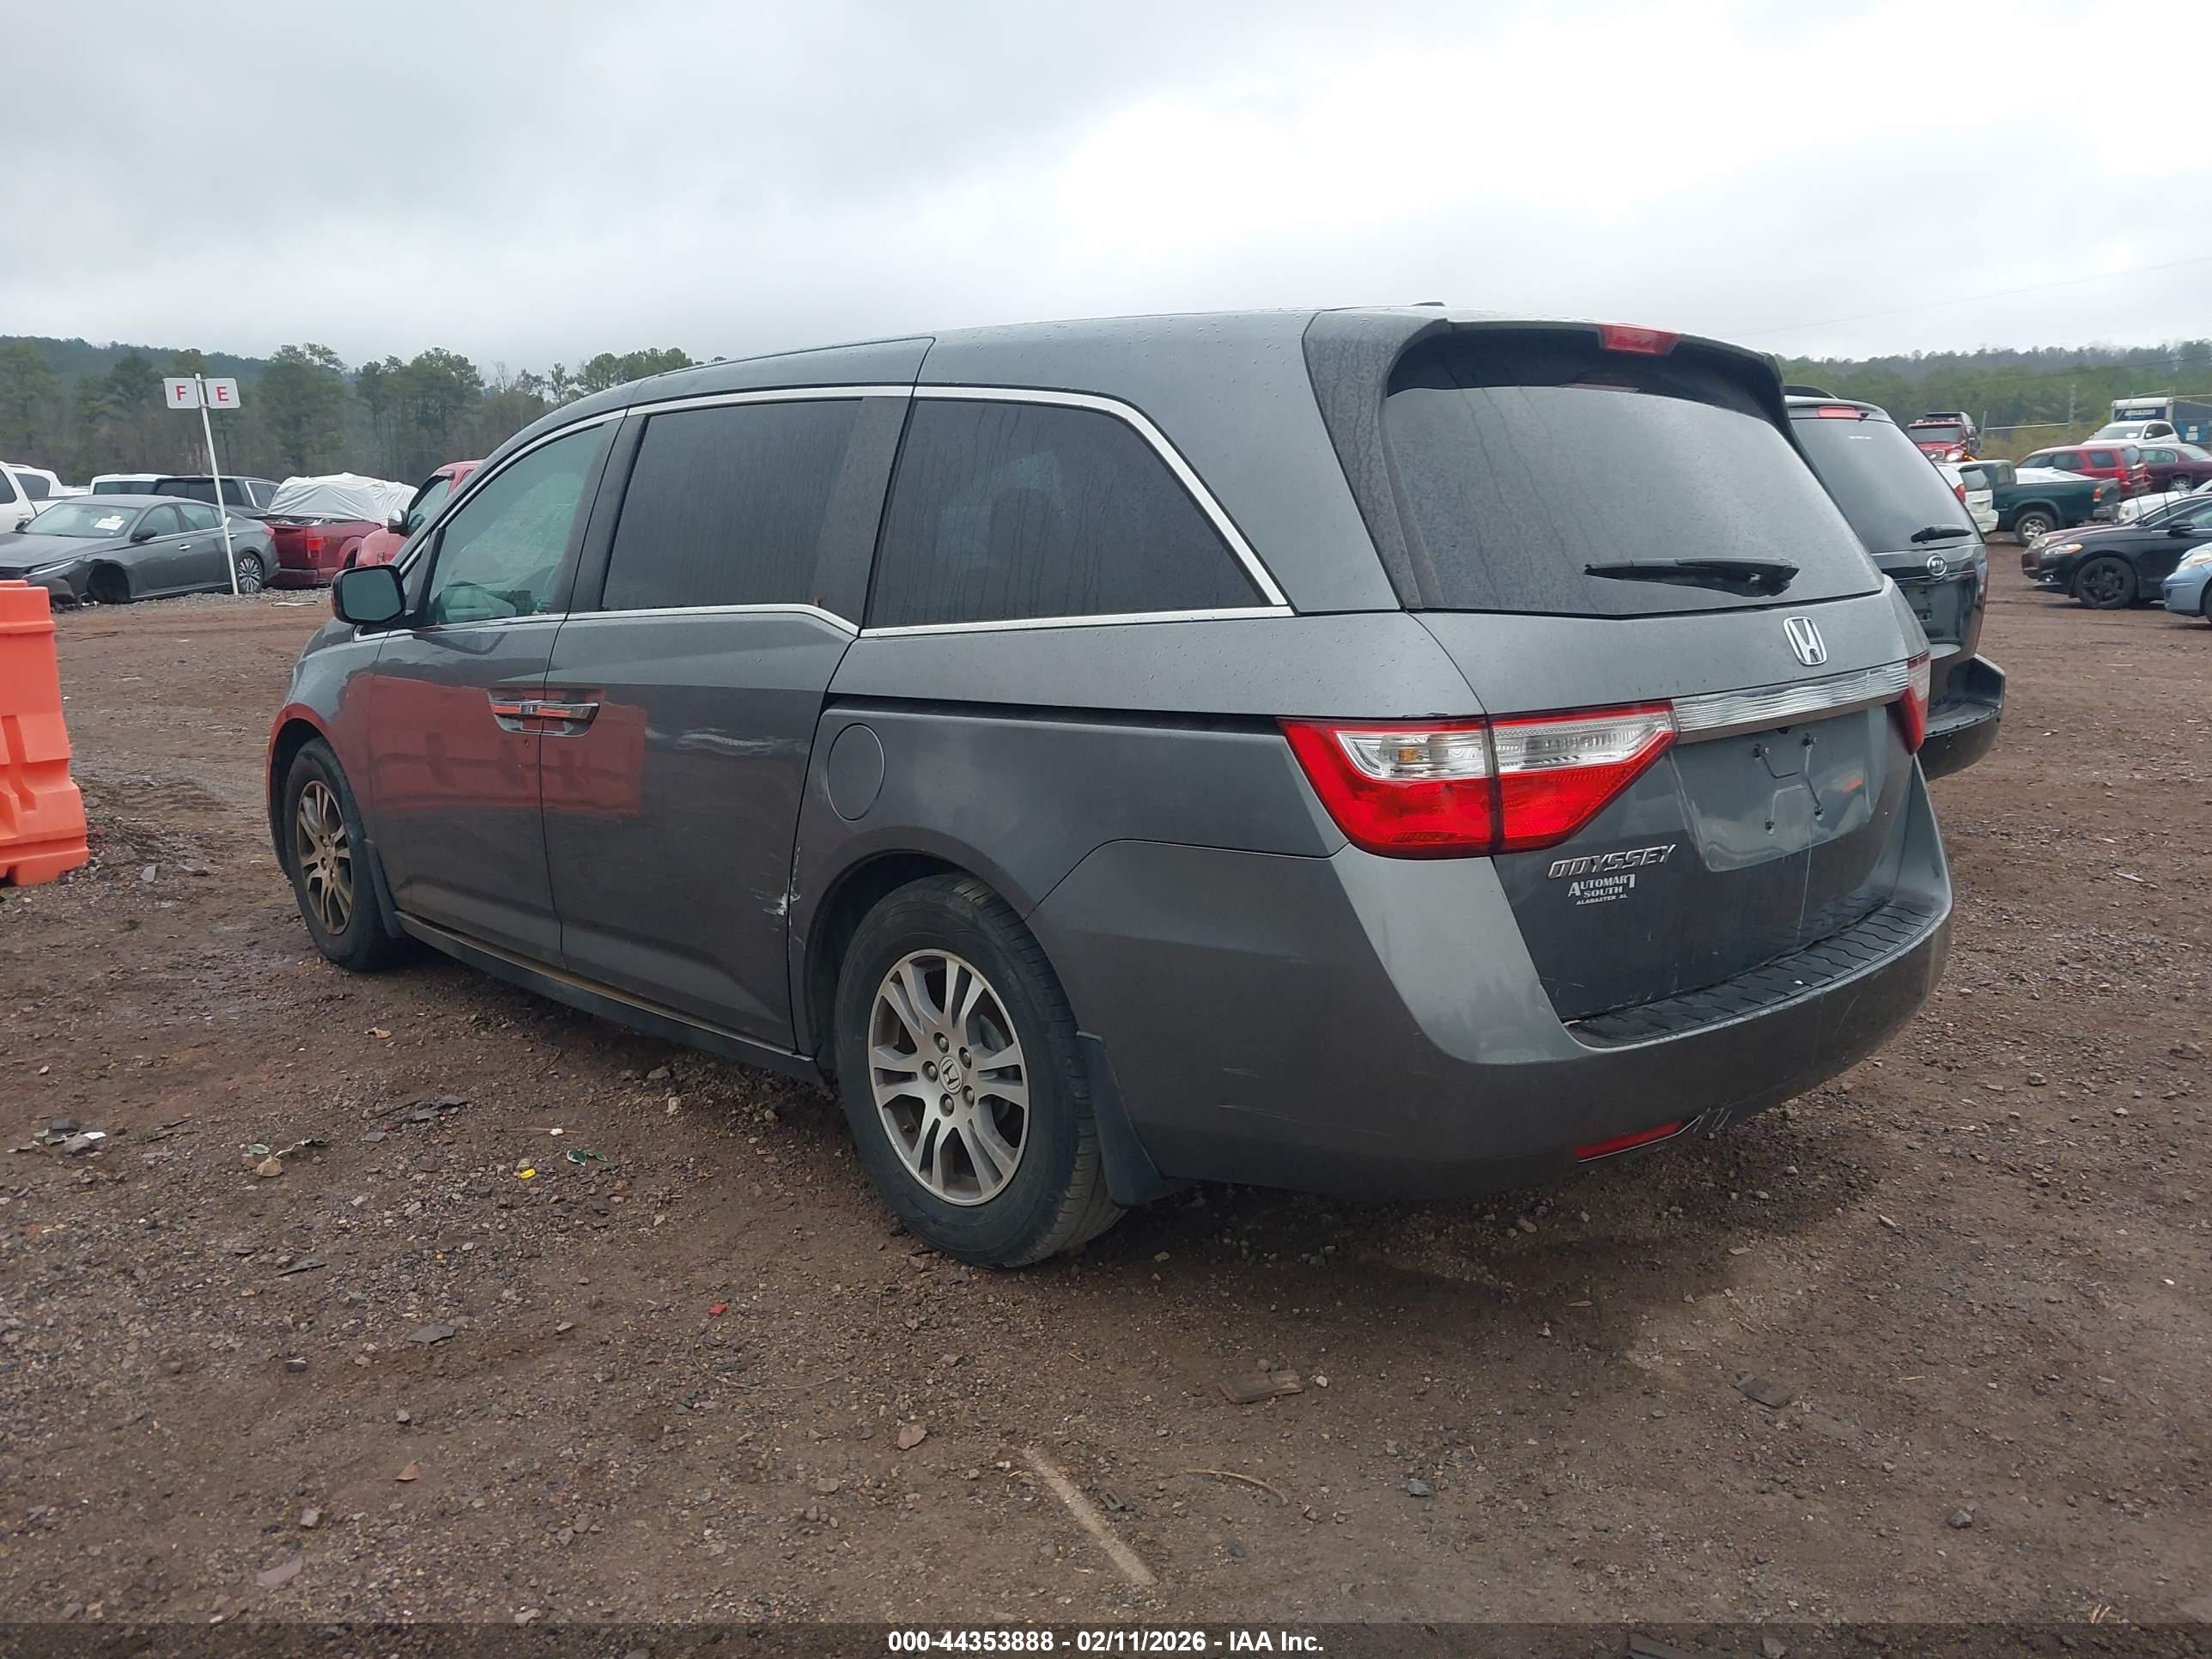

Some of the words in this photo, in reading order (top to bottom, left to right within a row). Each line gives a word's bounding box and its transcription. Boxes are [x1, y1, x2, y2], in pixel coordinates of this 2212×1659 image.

[175, 386, 186, 401] F
[216, 386, 229, 402] E
[1547, 844, 1677, 879] ODYSSEY
[1567, 873, 1636, 897] AUTOMART
[1583, 886, 1623, 898] SOUTH
